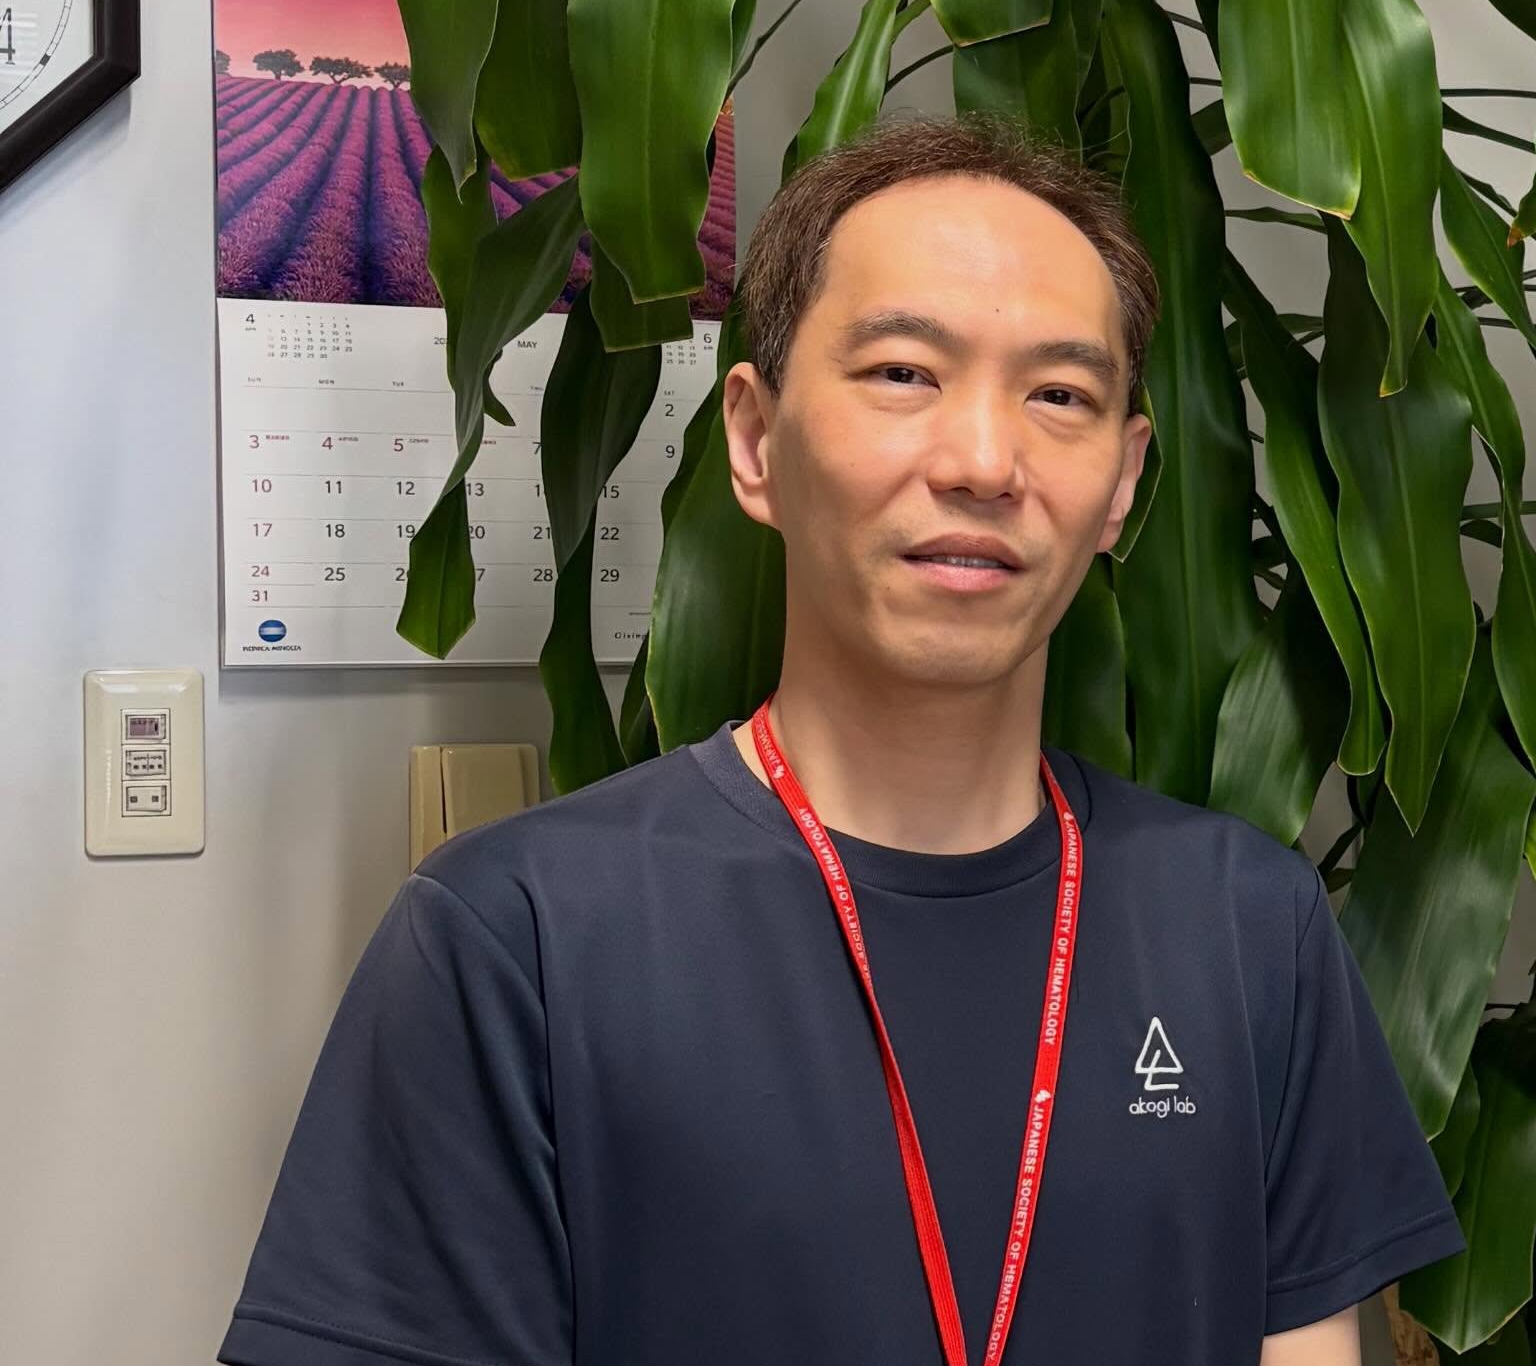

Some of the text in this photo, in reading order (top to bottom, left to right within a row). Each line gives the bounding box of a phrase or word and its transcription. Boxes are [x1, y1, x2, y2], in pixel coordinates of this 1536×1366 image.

[0, 7, 16, 66] 4
[245, 313, 255, 324] 4
[517, 340, 538, 348] MAY
[703, 333, 712, 344] 6
[664, 403, 675, 417] 2
[249, 435, 260, 449] 3
[321, 436, 334, 450] 4
[393, 438, 404, 452] 5
[532, 441, 541, 456] 7
[665, 444, 675, 458] 9
[252, 478, 272, 493] 10
[325, 480, 342, 494] 11
[396, 481, 415, 495] 12
[466, 483, 485, 497] 13
[602, 485, 620, 498] 15
[253, 523, 272, 537] 17
[325, 523, 345, 538] 18
[397, 524, 415, 539] 19
[533, 526, 551, 540] 21
[600, 527, 620, 540] 22
[251, 565, 270, 578] 24
[324, 567, 346, 581] 25
[395, 567, 409, 581] 2
[533, 568, 554, 582] 28
[600, 568, 620, 582] 29
[251, 590, 269, 602] 31
[799, 807, 842, 881] HEMATOLOGY
[835, 884, 849, 901] OF
[1044, 821, 1079, 1045] JAPANESE SOCIETY OF HEMATOLOGY
[1173, 1095, 1197, 1115] lab
[987, 1105, 1044, 1360] JAPANESE SOCIETY OF HEMATOLOGY
